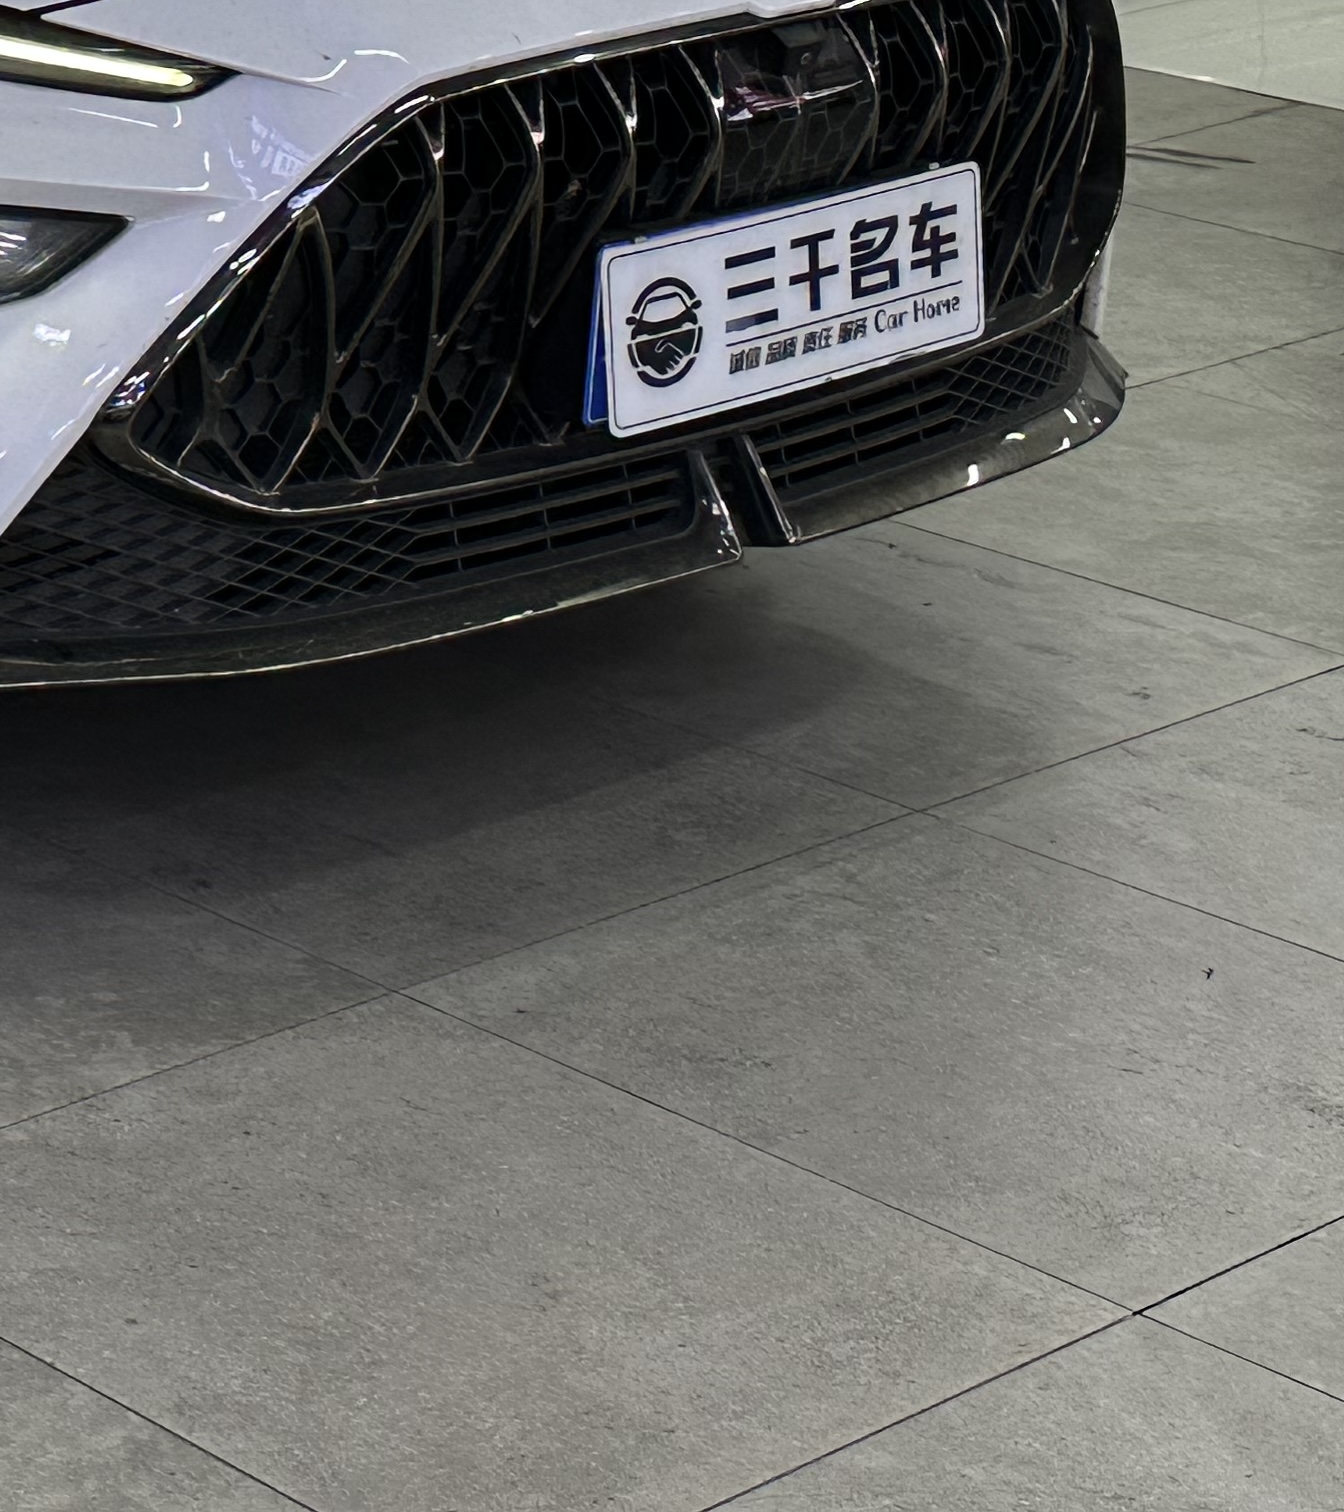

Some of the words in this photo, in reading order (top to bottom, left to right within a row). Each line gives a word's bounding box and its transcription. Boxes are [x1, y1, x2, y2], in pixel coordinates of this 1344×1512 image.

[724, 200, 961, 334] 三千名车
[874, 308, 909, 334] Car
[913, 295, 962, 324] Home
